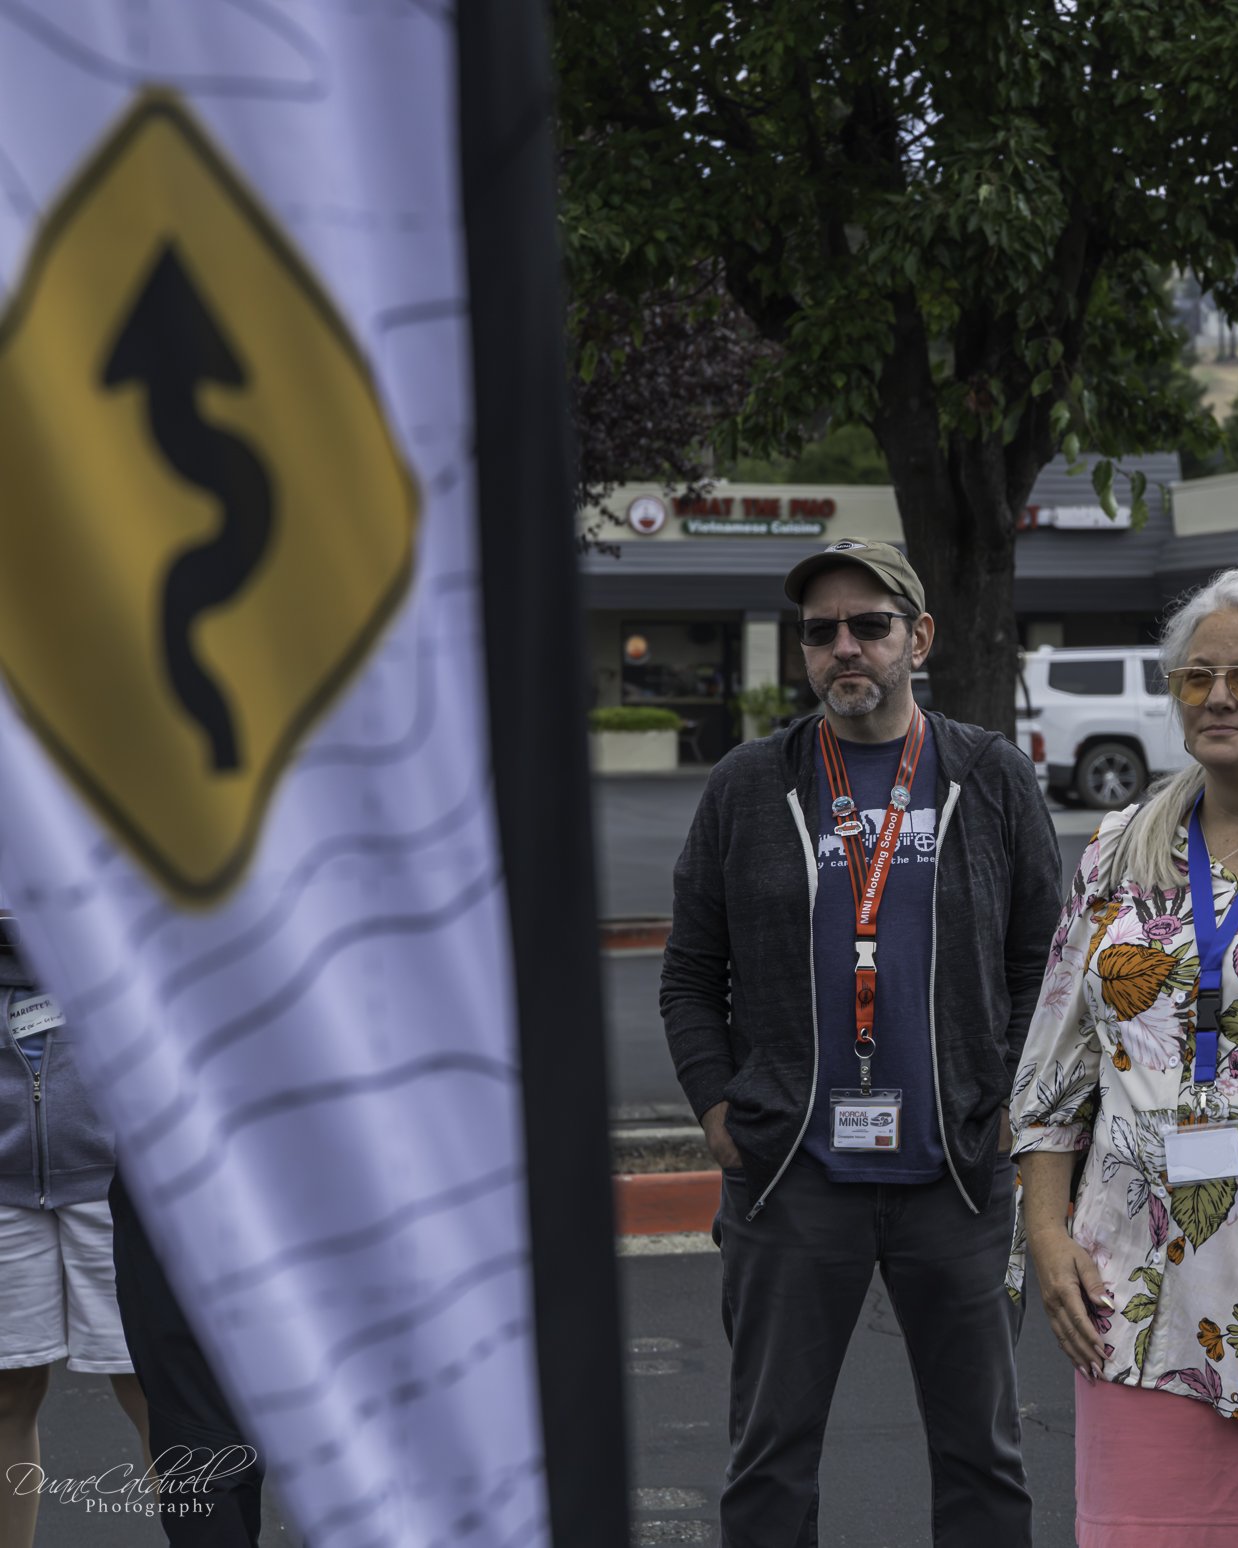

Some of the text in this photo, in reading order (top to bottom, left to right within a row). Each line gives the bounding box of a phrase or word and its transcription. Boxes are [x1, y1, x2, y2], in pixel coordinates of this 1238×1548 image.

[741, 496, 781, 518] THE
[789, 496, 836, 518] PHO
[687, 520, 821, 534] Vietnamese Cuisine
[880, 812, 899, 848] School
[866, 851, 889, 898] Motoring
[860, 900, 873, 924] MINI
[838, 1117, 869, 1127] MINIS
[839, 1110, 869, 1118] NORCAL
